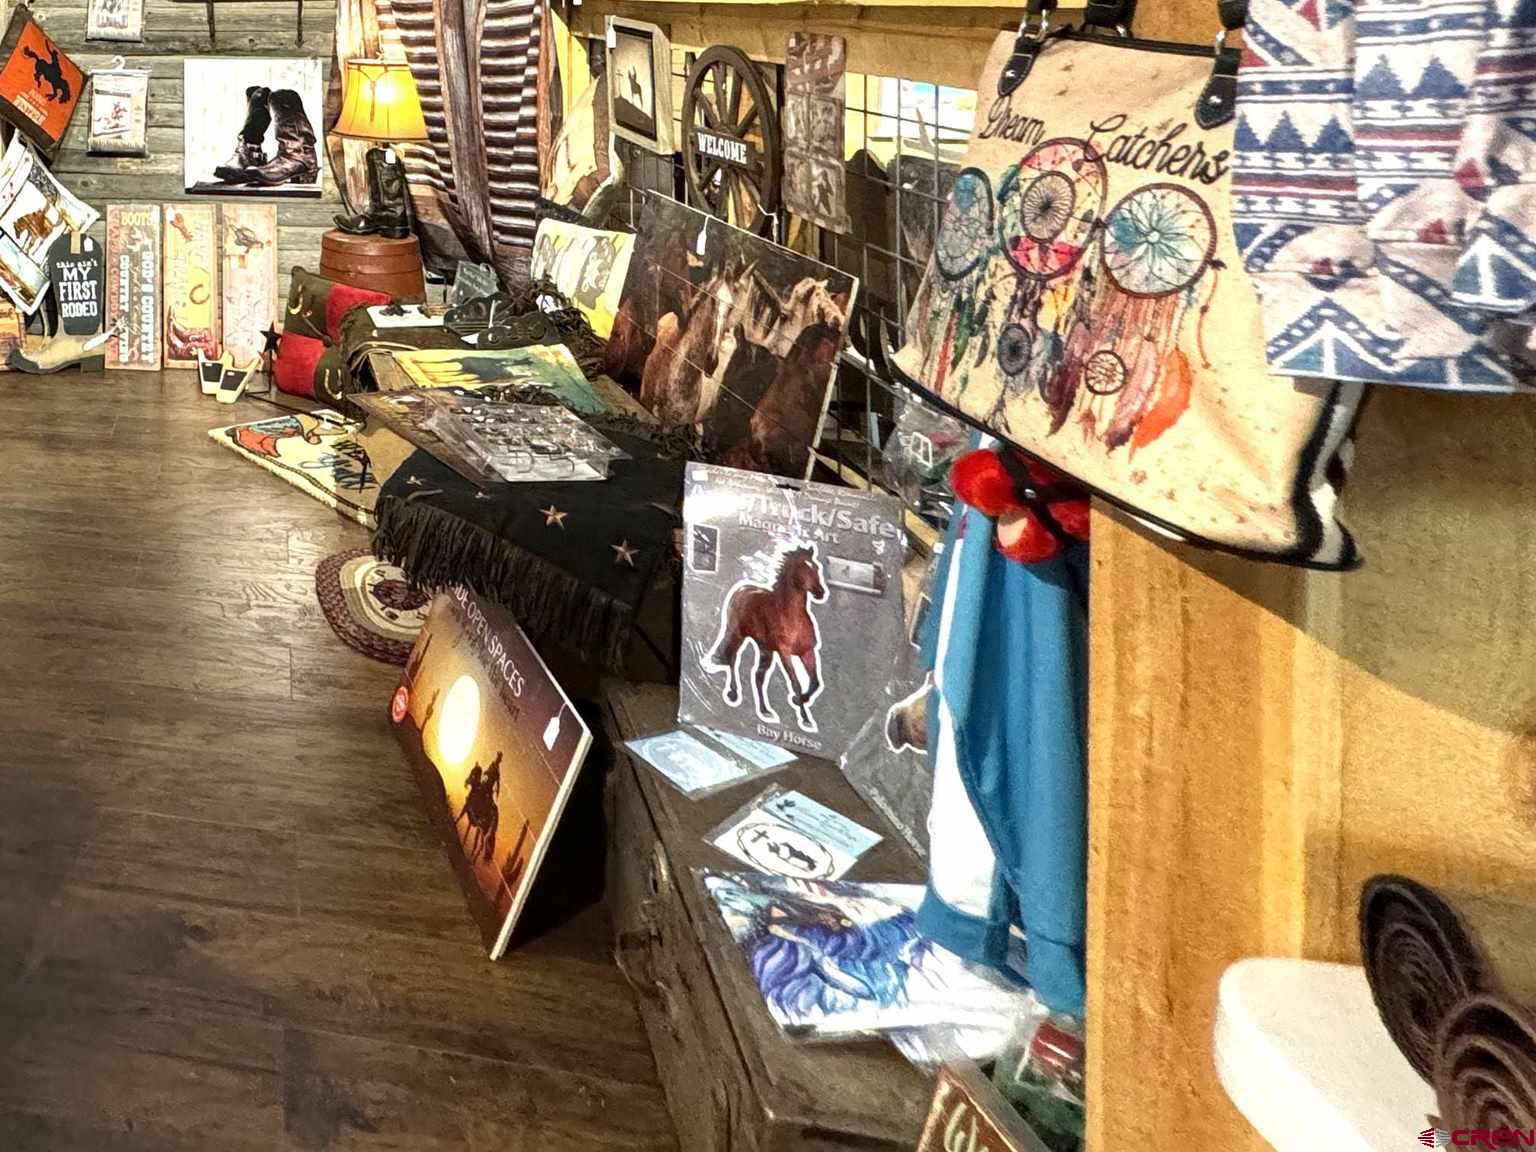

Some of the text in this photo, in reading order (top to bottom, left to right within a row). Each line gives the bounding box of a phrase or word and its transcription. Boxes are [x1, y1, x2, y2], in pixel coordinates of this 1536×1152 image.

[696, 131, 747, 164] WELCOME
[979, 97, 1230, 185] Dream Catchers
[58, 280, 98, 301] FIRST
[63, 267, 92, 281] MY
[61, 301, 98, 318] RODEO
[141, 296, 154, 363] COUNTRY
[738, 511, 841, 545] Magnic Art
[467, 602, 491, 646] OPEN
[488, 635, 525, 697] SPACES
[756, 723, 823, 751] Bay Horse
